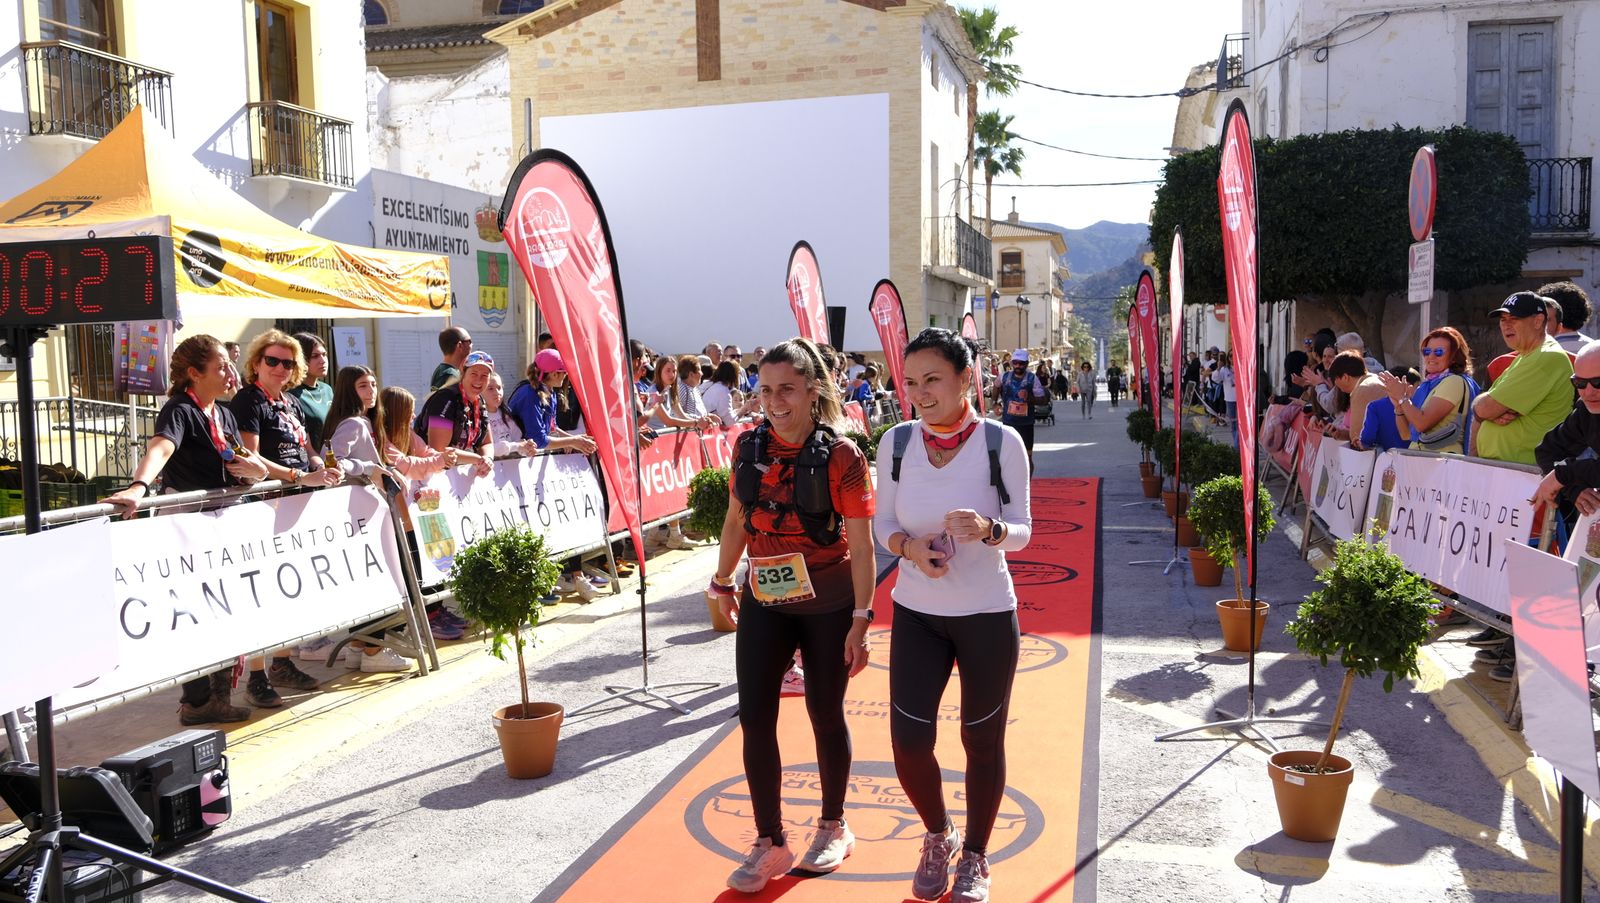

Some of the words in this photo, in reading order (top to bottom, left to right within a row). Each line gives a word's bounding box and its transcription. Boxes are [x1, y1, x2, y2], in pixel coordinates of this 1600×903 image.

[382, 197, 470, 229] EXCELENTÍSIMO
[189, 247, 203, 255] uno
[385, 228, 470, 256] AYUNTAMIENTO
[457, 479, 566, 508] AYUNTAMIENTO
[571, 475, 587, 489] DE
[639, 456, 696, 497] VEOLIA
[461, 493, 596, 545] CANTORIA
[1497, 505, 1520, 528] DE
[114, 525, 335, 586] AYUNTAMIENTO
[343, 517, 369, 538] DE
[1391, 506, 1516, 572] CANTORI
[119, 542, 384, 640] CANTORIA
[757, 566, 796, 585] 532
[25, 866, 44, 903] VONY
